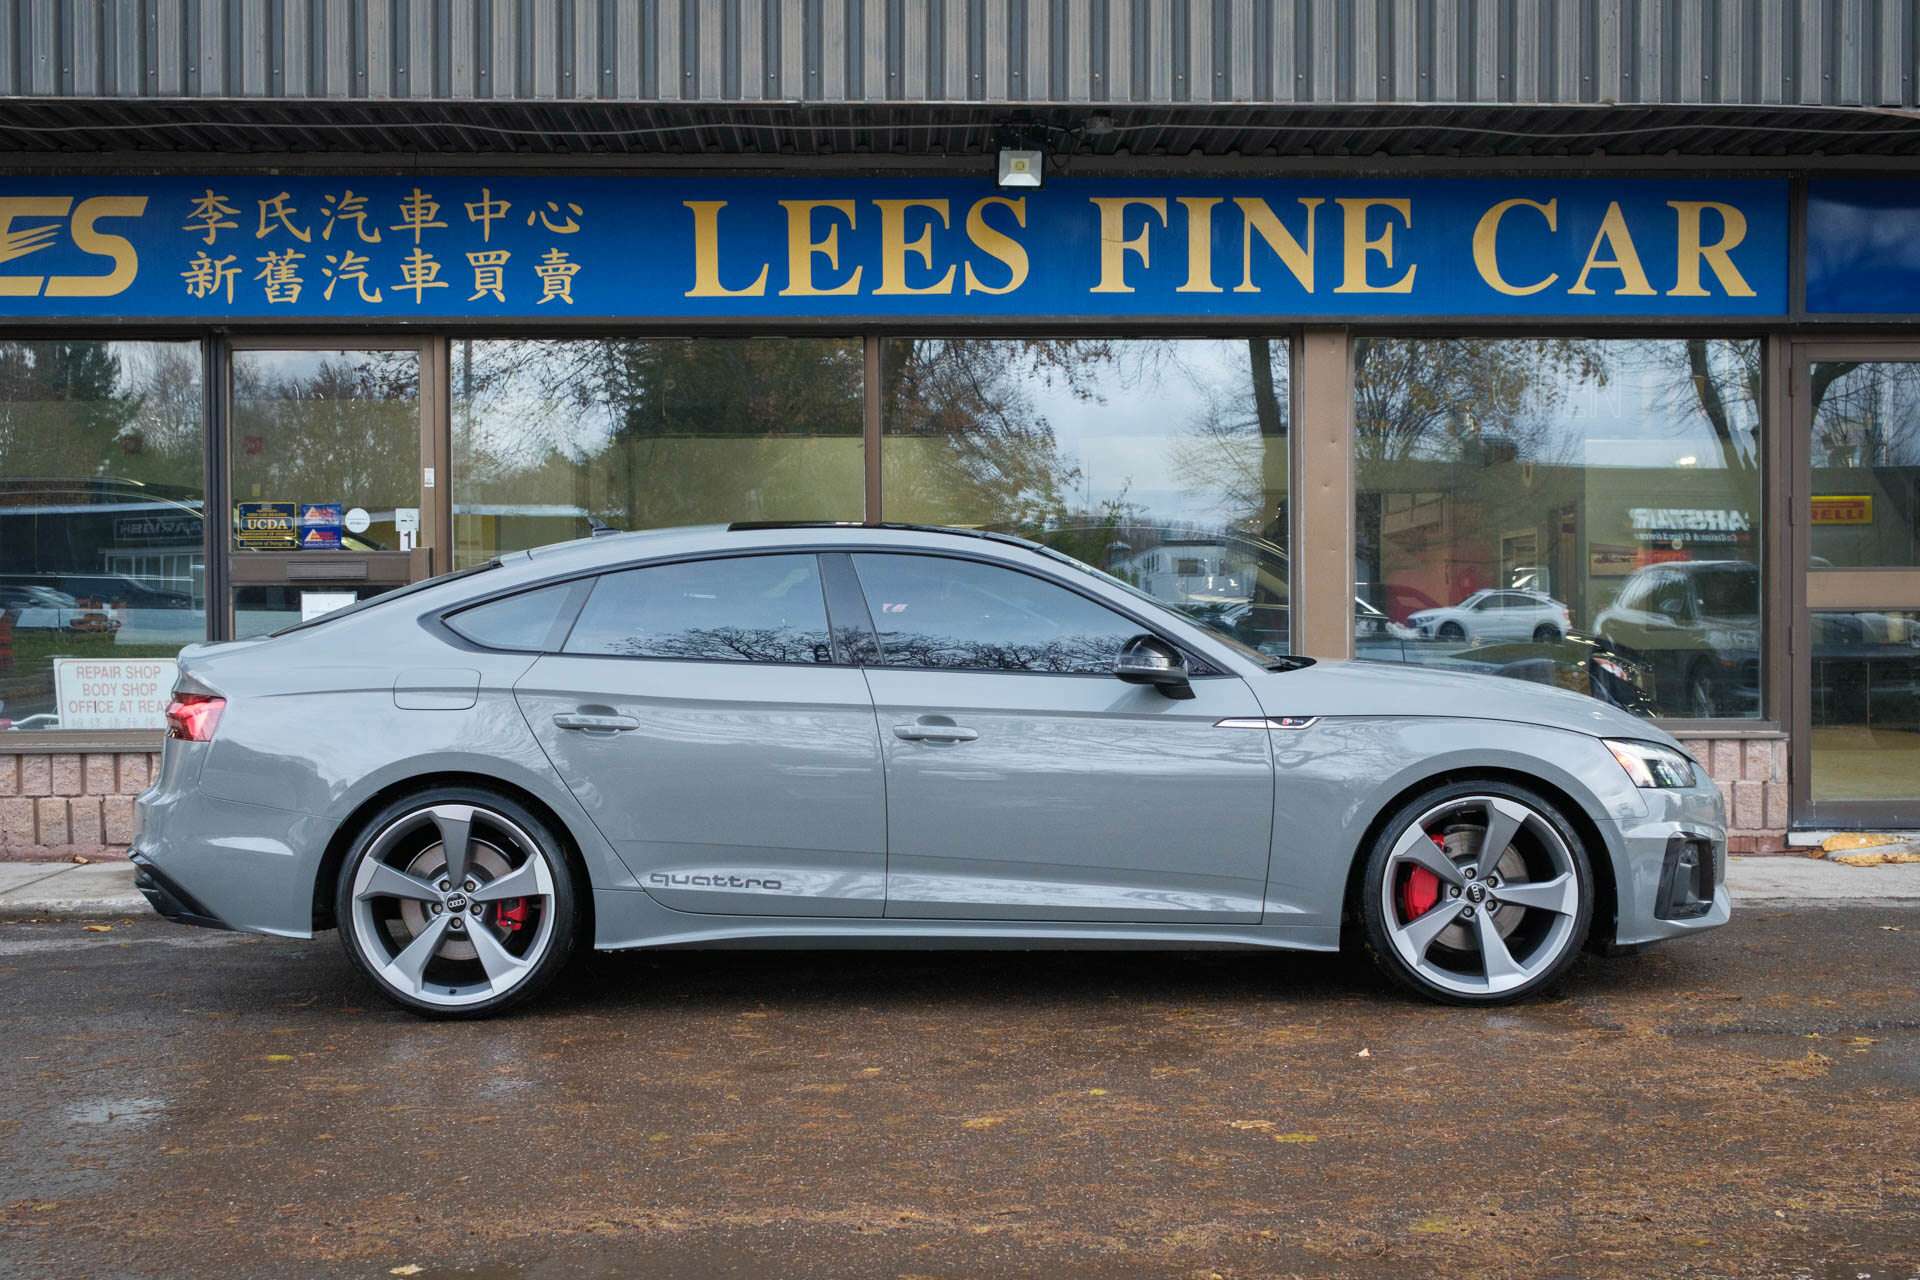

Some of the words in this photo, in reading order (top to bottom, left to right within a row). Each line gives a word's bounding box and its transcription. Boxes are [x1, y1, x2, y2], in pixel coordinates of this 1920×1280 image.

[180, 188, 583, 245] 李氏汽車中心
[682, 196, 1030, 297] LEES
[1089, 197, 1417, 294] FINE
[1472, 198, 1757, 297] CAR
[180, 247, 582, 305] 新舊汽車買賣
[247, 518, 289, 530] UCDA
[403, 531, 412, 550] 1
[76, 665, 121, 680] REPAIR
[126, 665, 161, 679] SHOP
[82, 683, 117, 697] BODY
[122, 683, 158, 696] SHOP
[68, 700, 114, 714] OFFICE
[119, 700, 133, 714] AT
[649, 872, 783, 890] quattro
